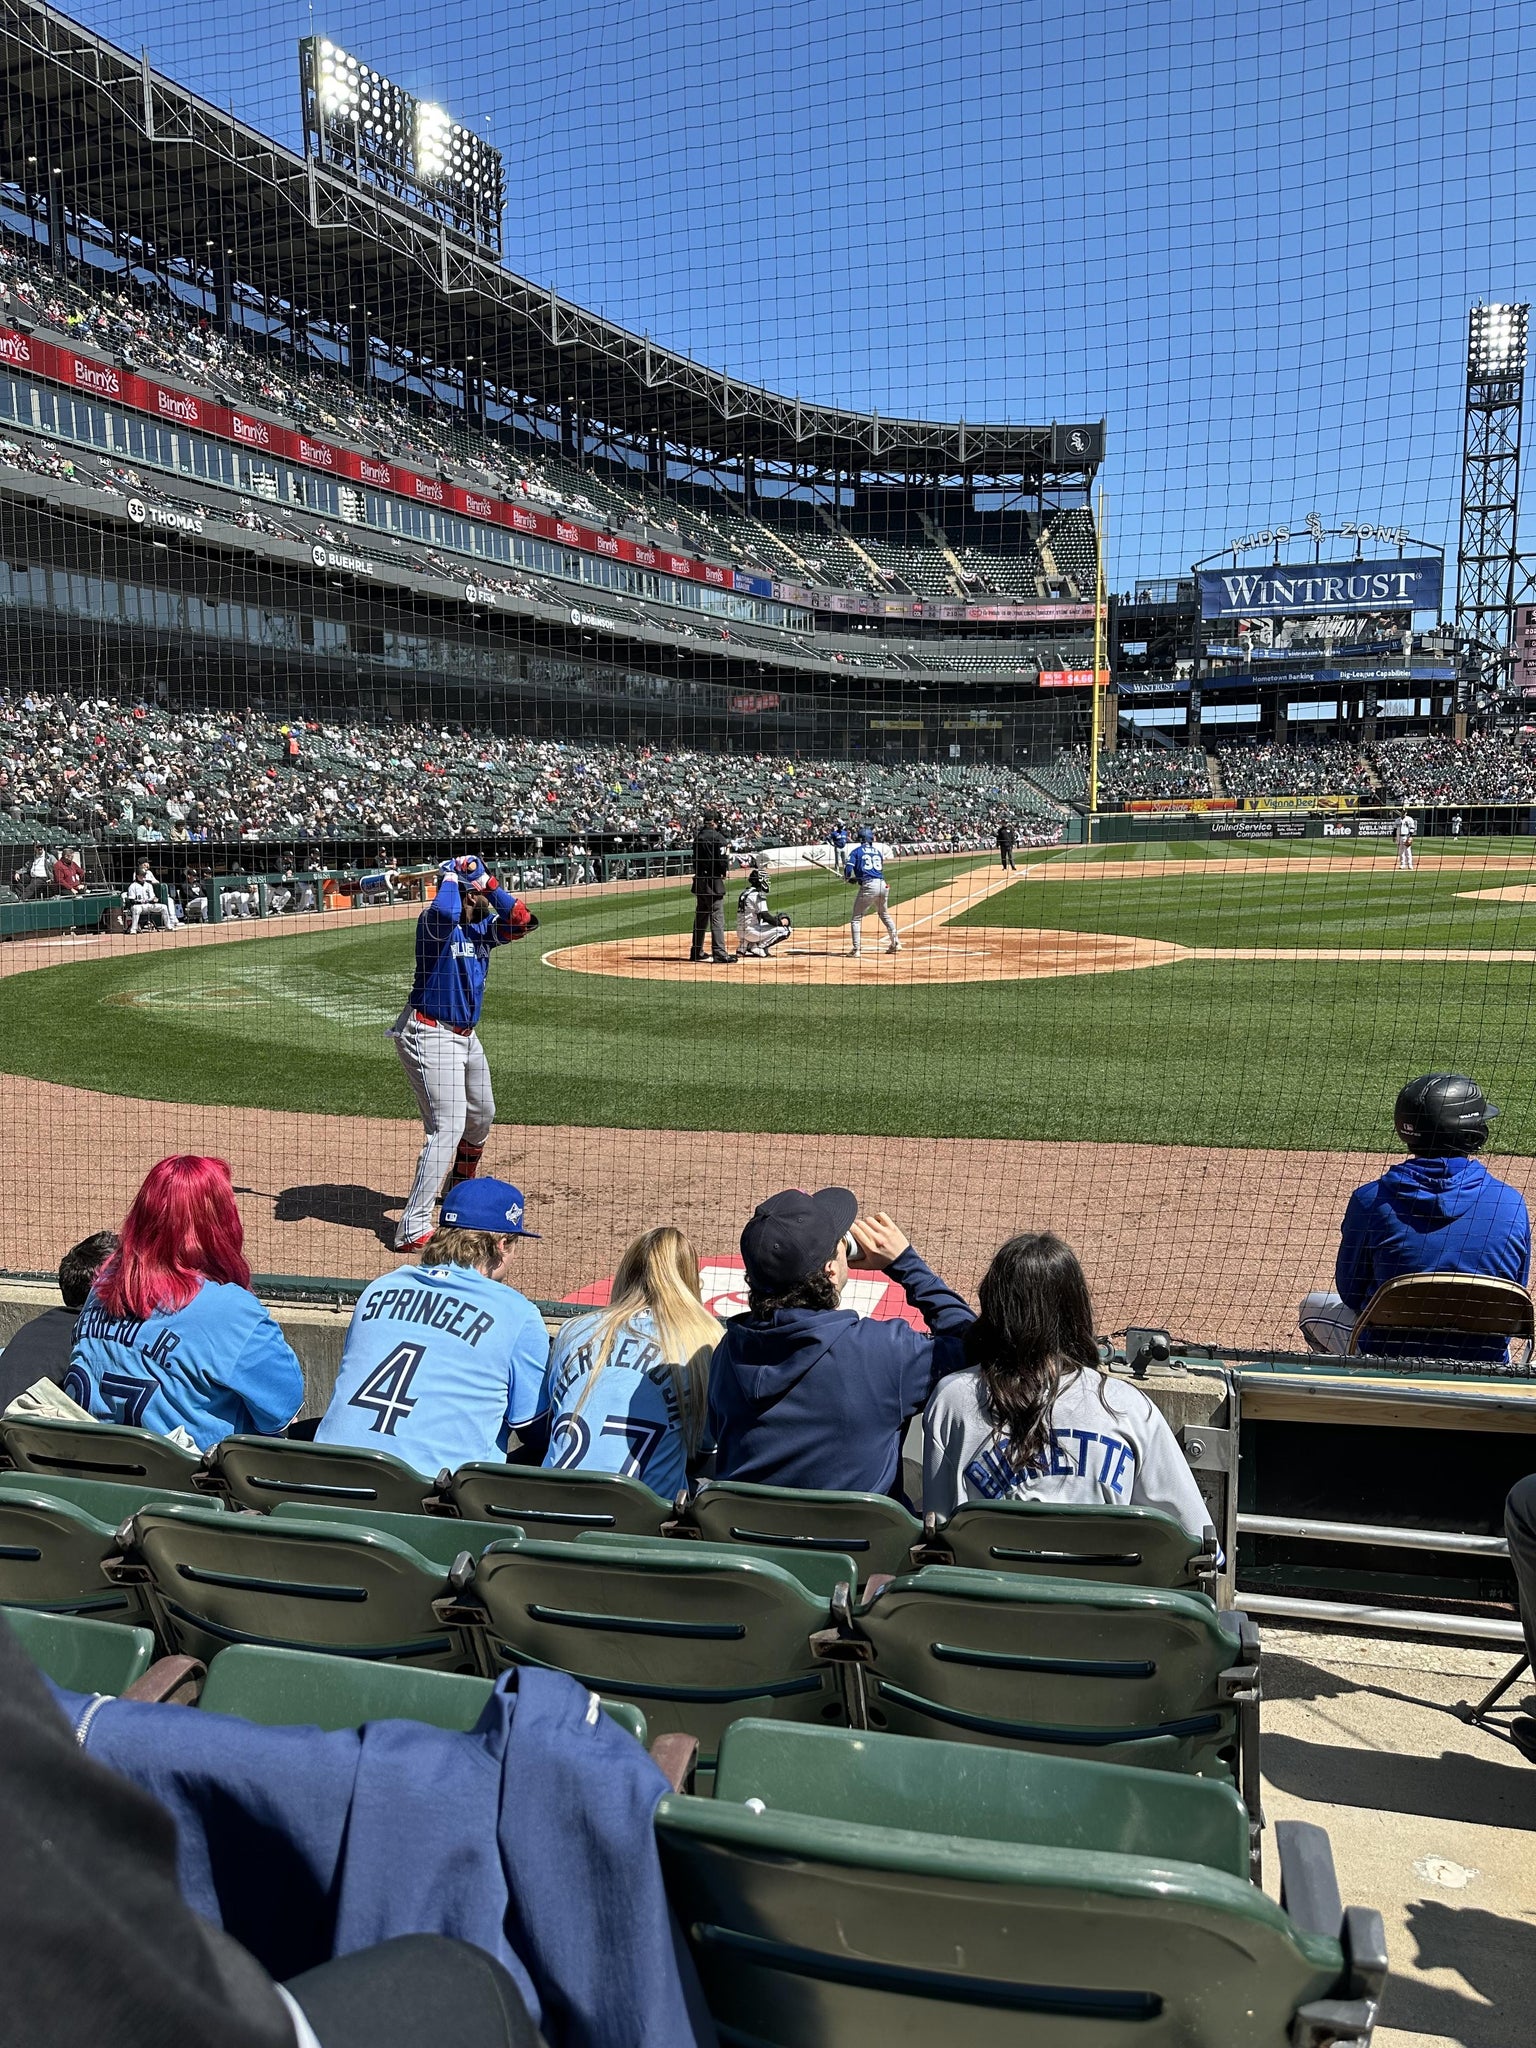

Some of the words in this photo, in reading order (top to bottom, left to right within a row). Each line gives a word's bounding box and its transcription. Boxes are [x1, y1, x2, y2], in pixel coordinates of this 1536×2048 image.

[74, 360, 119, 393] Binny's
[158, 390, 198, 420] Binny's
[233, 416, 269, 444] Binny's
[300, 440, 332, 465] Binny's
[360, 460, 390, 484] Binny's
[416, 478, 443, 501] Binny's
[466, 495, 492, 517] Binny's
[130, 503, 143, 516] 35
[149, 508, 203, 534] THOMAS
[513, 509, 537, 530] Binny's
[1230, 526, 1290, 555] KIDS
[1339, 522, 1410, 547] ZONE
[314, 551, 326, 562] 56
[328, 551, 374, 576] BUEHRLE
[478, 591, 496, 605] FISK
[582, 615, 615, 630] ROBINSON
[1253, 674, 1287, 683] Hometown
[1288, 673, 1314, 682] Banking
[1340, 671, 1374, 680] Big-League
[1376, 669, 1411, 678] Capabilities
[1133, 682, 1175, 691] WINTRUST
[1152, 802, 1189, 813] Surfside
[1263, 798, 1294, 807] Vienna
[1296, 797, 1316, 807] Beef
[1323, 822, 1352, 835] Rate
[862, 854, 882, 870] 38
[361, 1289, 494, 1347] SPRINGER
[142, 1328, 180, 1369] JR.
[349, 1341, 427, 1436] 4
[552, 1412, 667, 1480] 27
